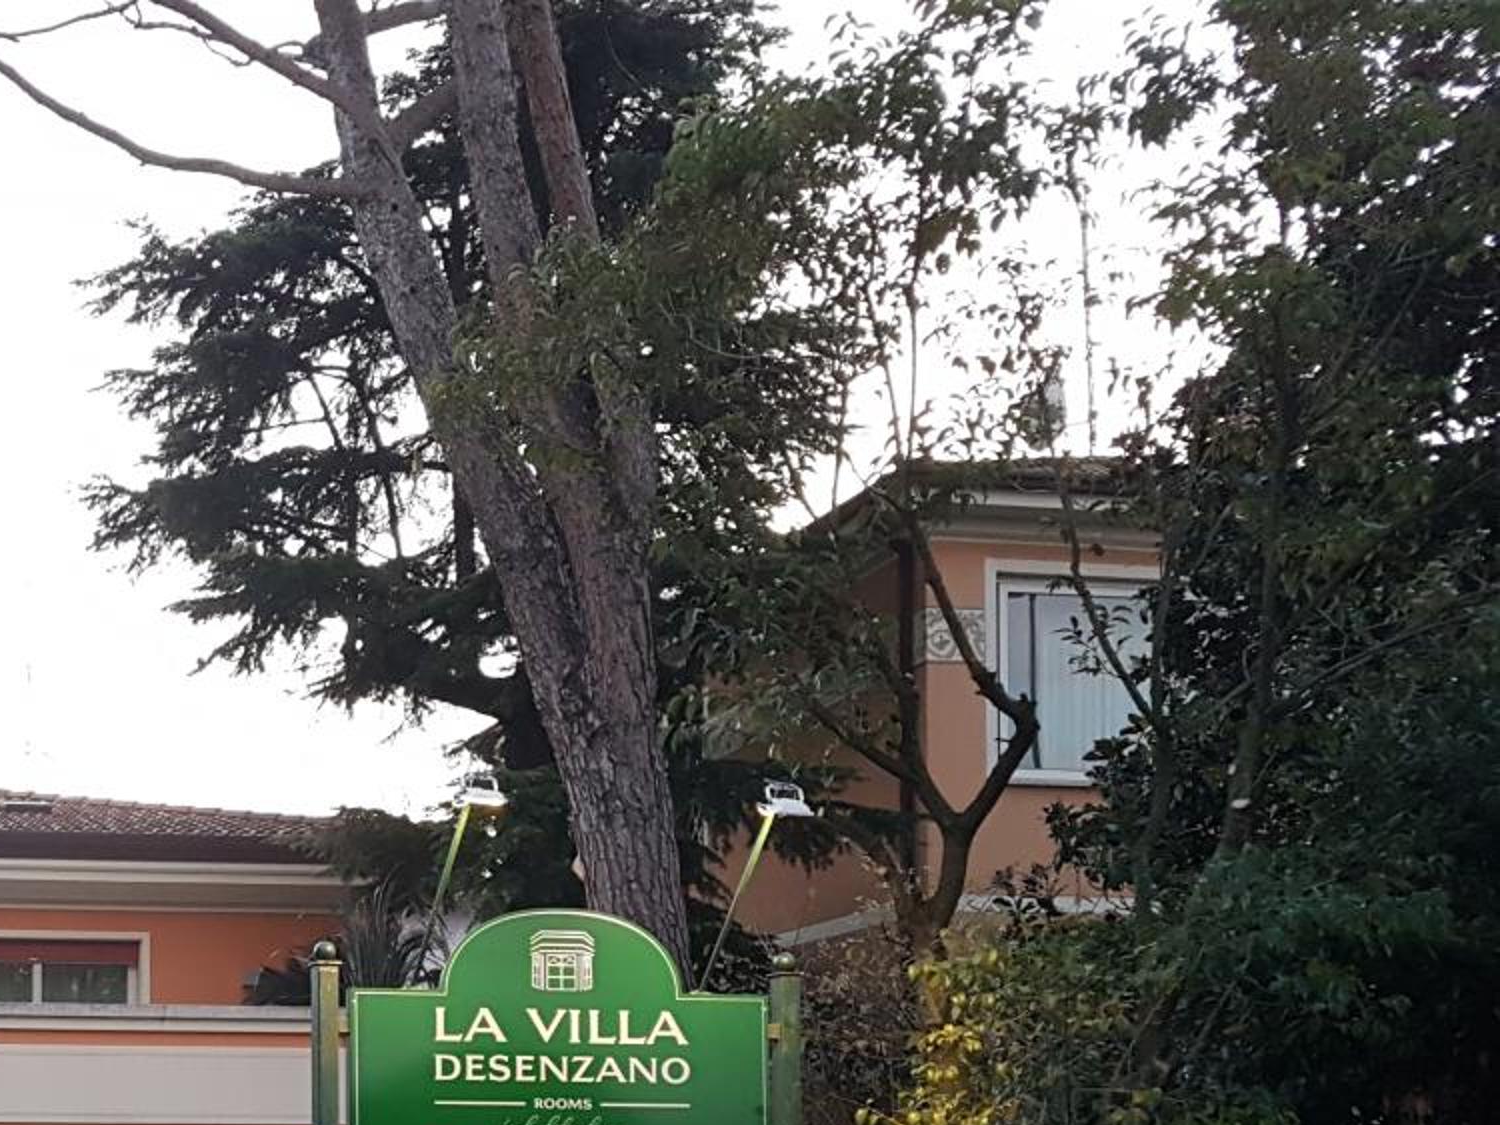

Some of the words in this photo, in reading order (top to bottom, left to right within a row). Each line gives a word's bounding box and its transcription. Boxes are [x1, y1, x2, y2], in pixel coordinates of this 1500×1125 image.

[434, 1006, 508, 1043] LA
[525, 1007, 689, 1046] VILLA
[434, 1053, 691, 1085] DESENZANO
[533, 1098, 593, 1110] ROOMS
